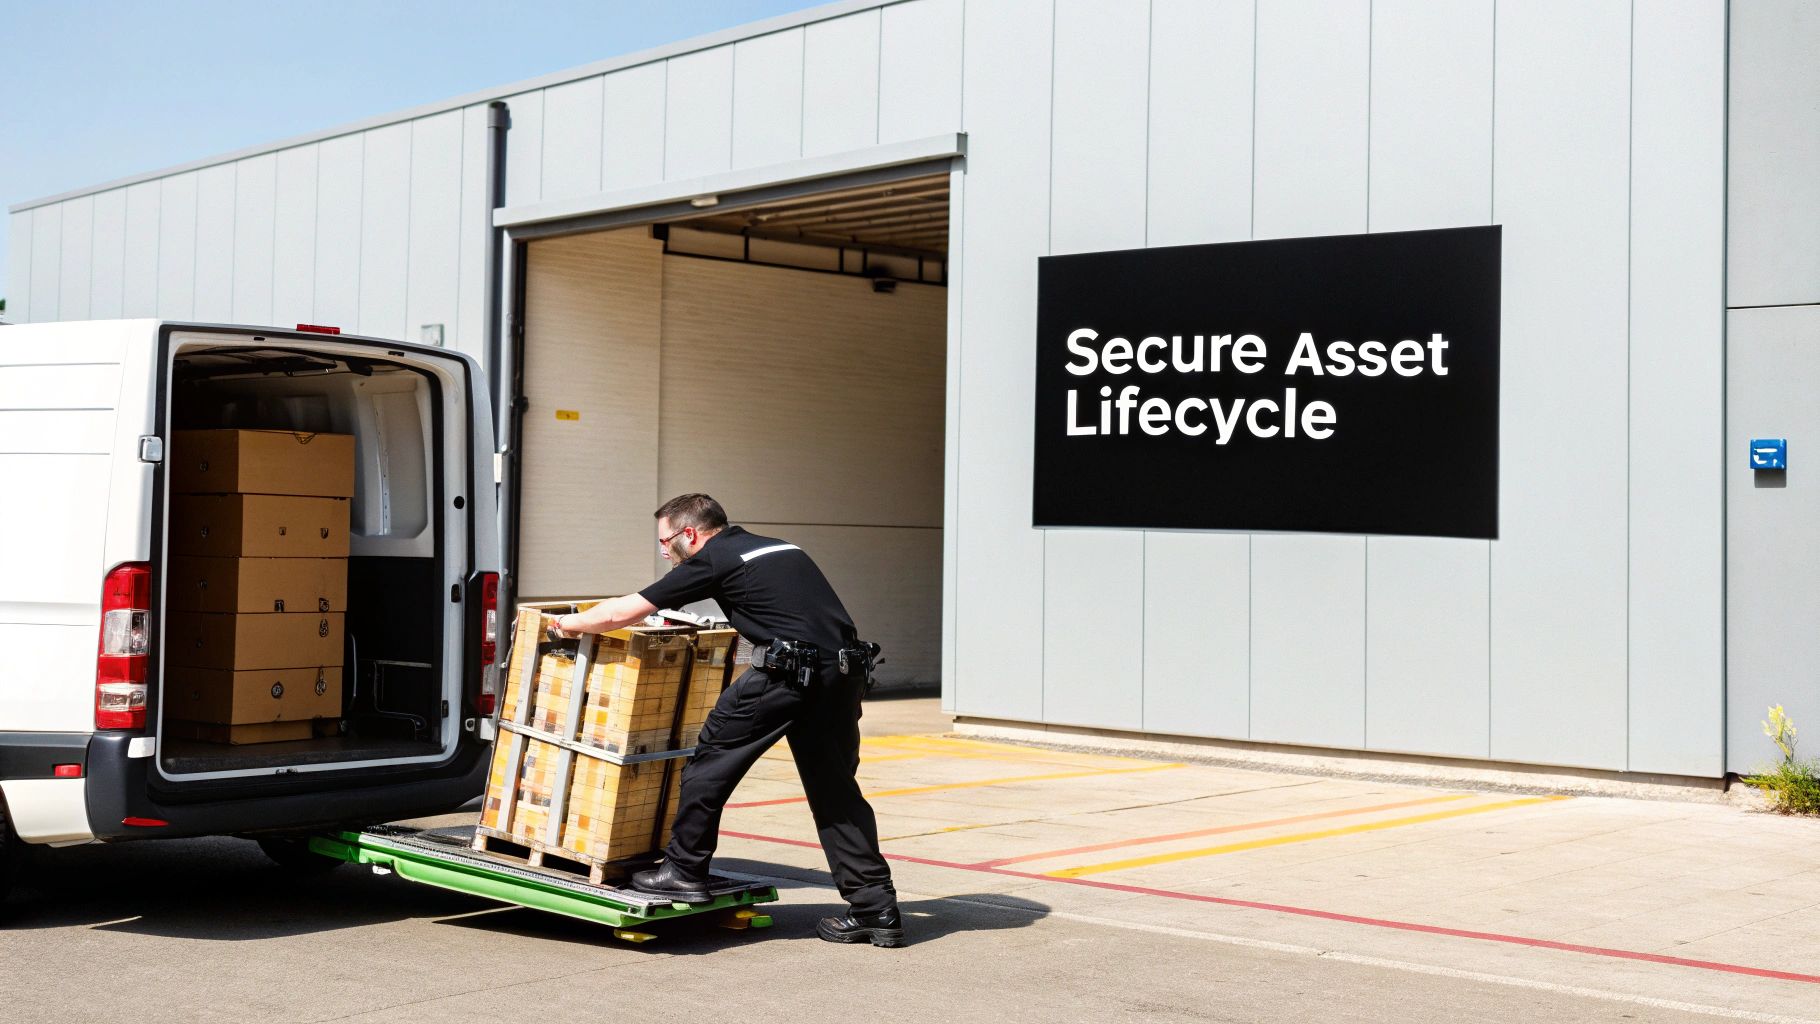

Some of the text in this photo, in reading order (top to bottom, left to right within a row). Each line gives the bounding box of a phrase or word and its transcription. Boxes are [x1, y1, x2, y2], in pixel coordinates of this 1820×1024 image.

[1065, 327, 1449, 377] Secure Asset
[1066, 385, 1337, 446] Lifecycle
